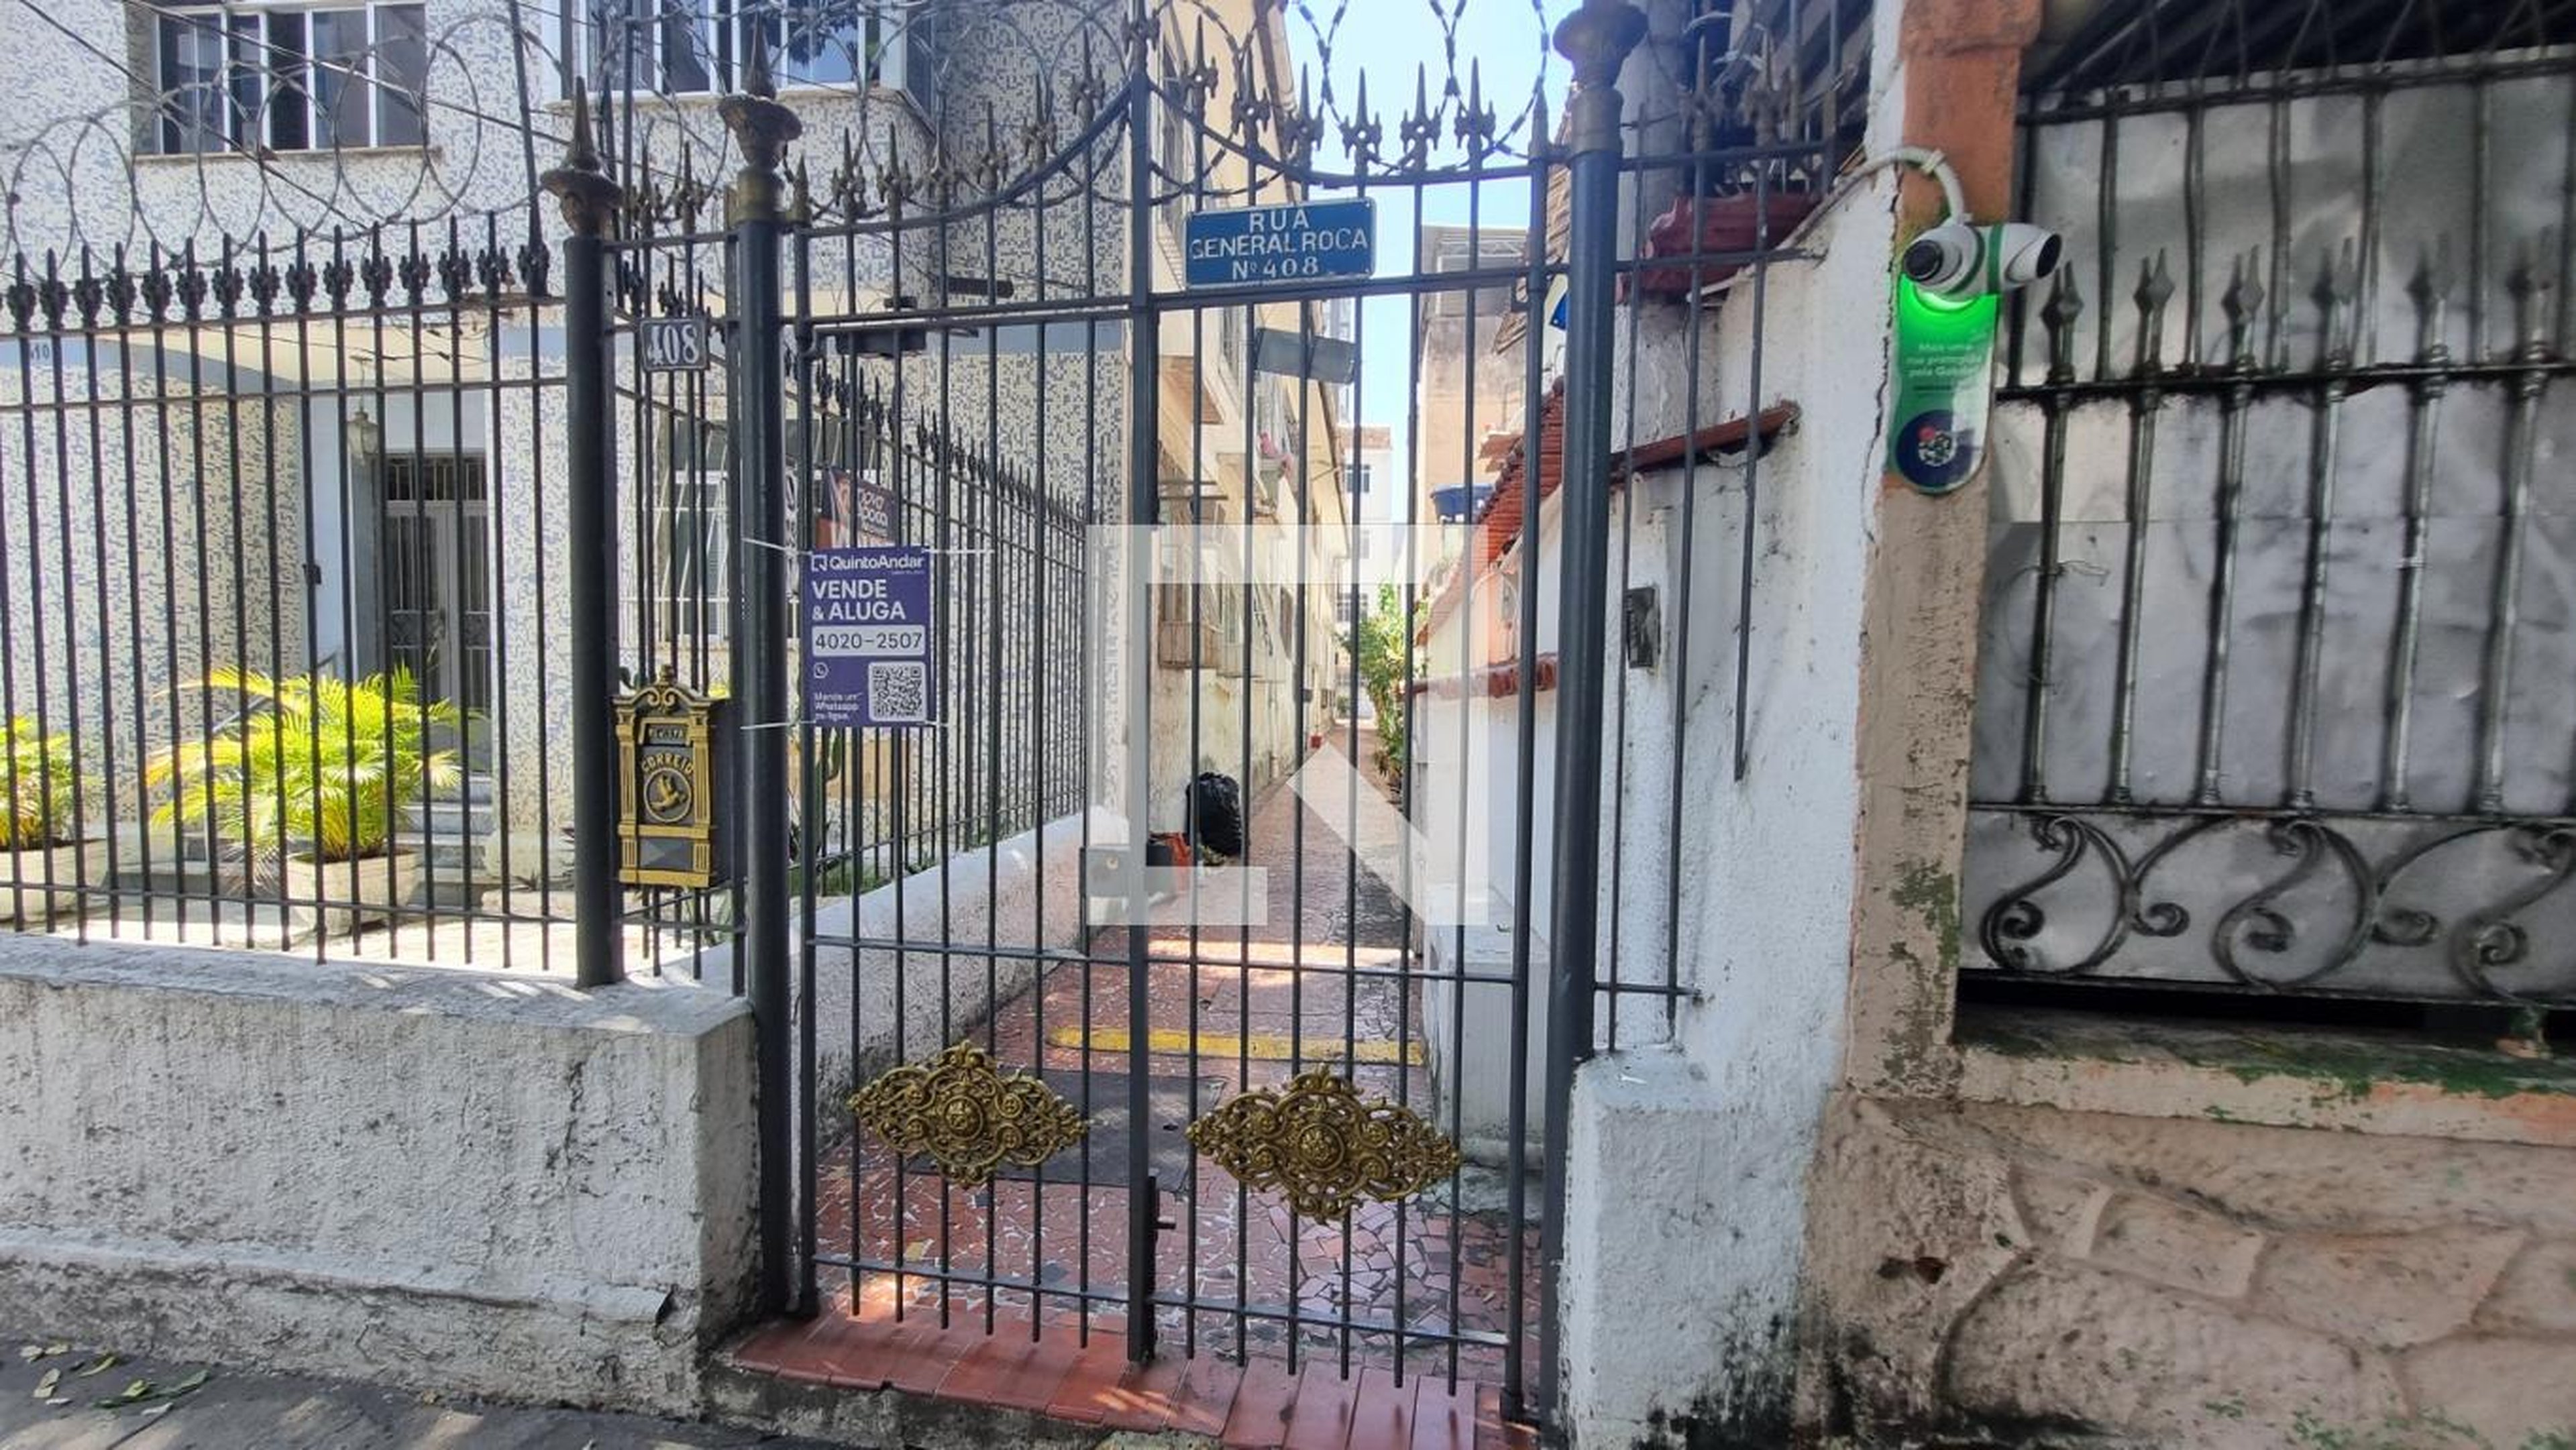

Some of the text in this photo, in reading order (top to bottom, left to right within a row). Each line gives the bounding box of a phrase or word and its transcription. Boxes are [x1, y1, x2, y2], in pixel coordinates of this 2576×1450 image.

[1249, 209, 1309, 233] RUA
[1191, 227, 1368, 260] GENERAL ROCA
[1263, 256, 1319, 277] 408
[647, 324, 699, 365] 408
[829, 554, 925, 570] QuintoAndar
[812, 579, 888, 599] VENDE
[812, 601, 906, 620] & ALUGA
[815, 632, 922, 649] 4020-2507
[641, 752, 696, 774] CORREIO
